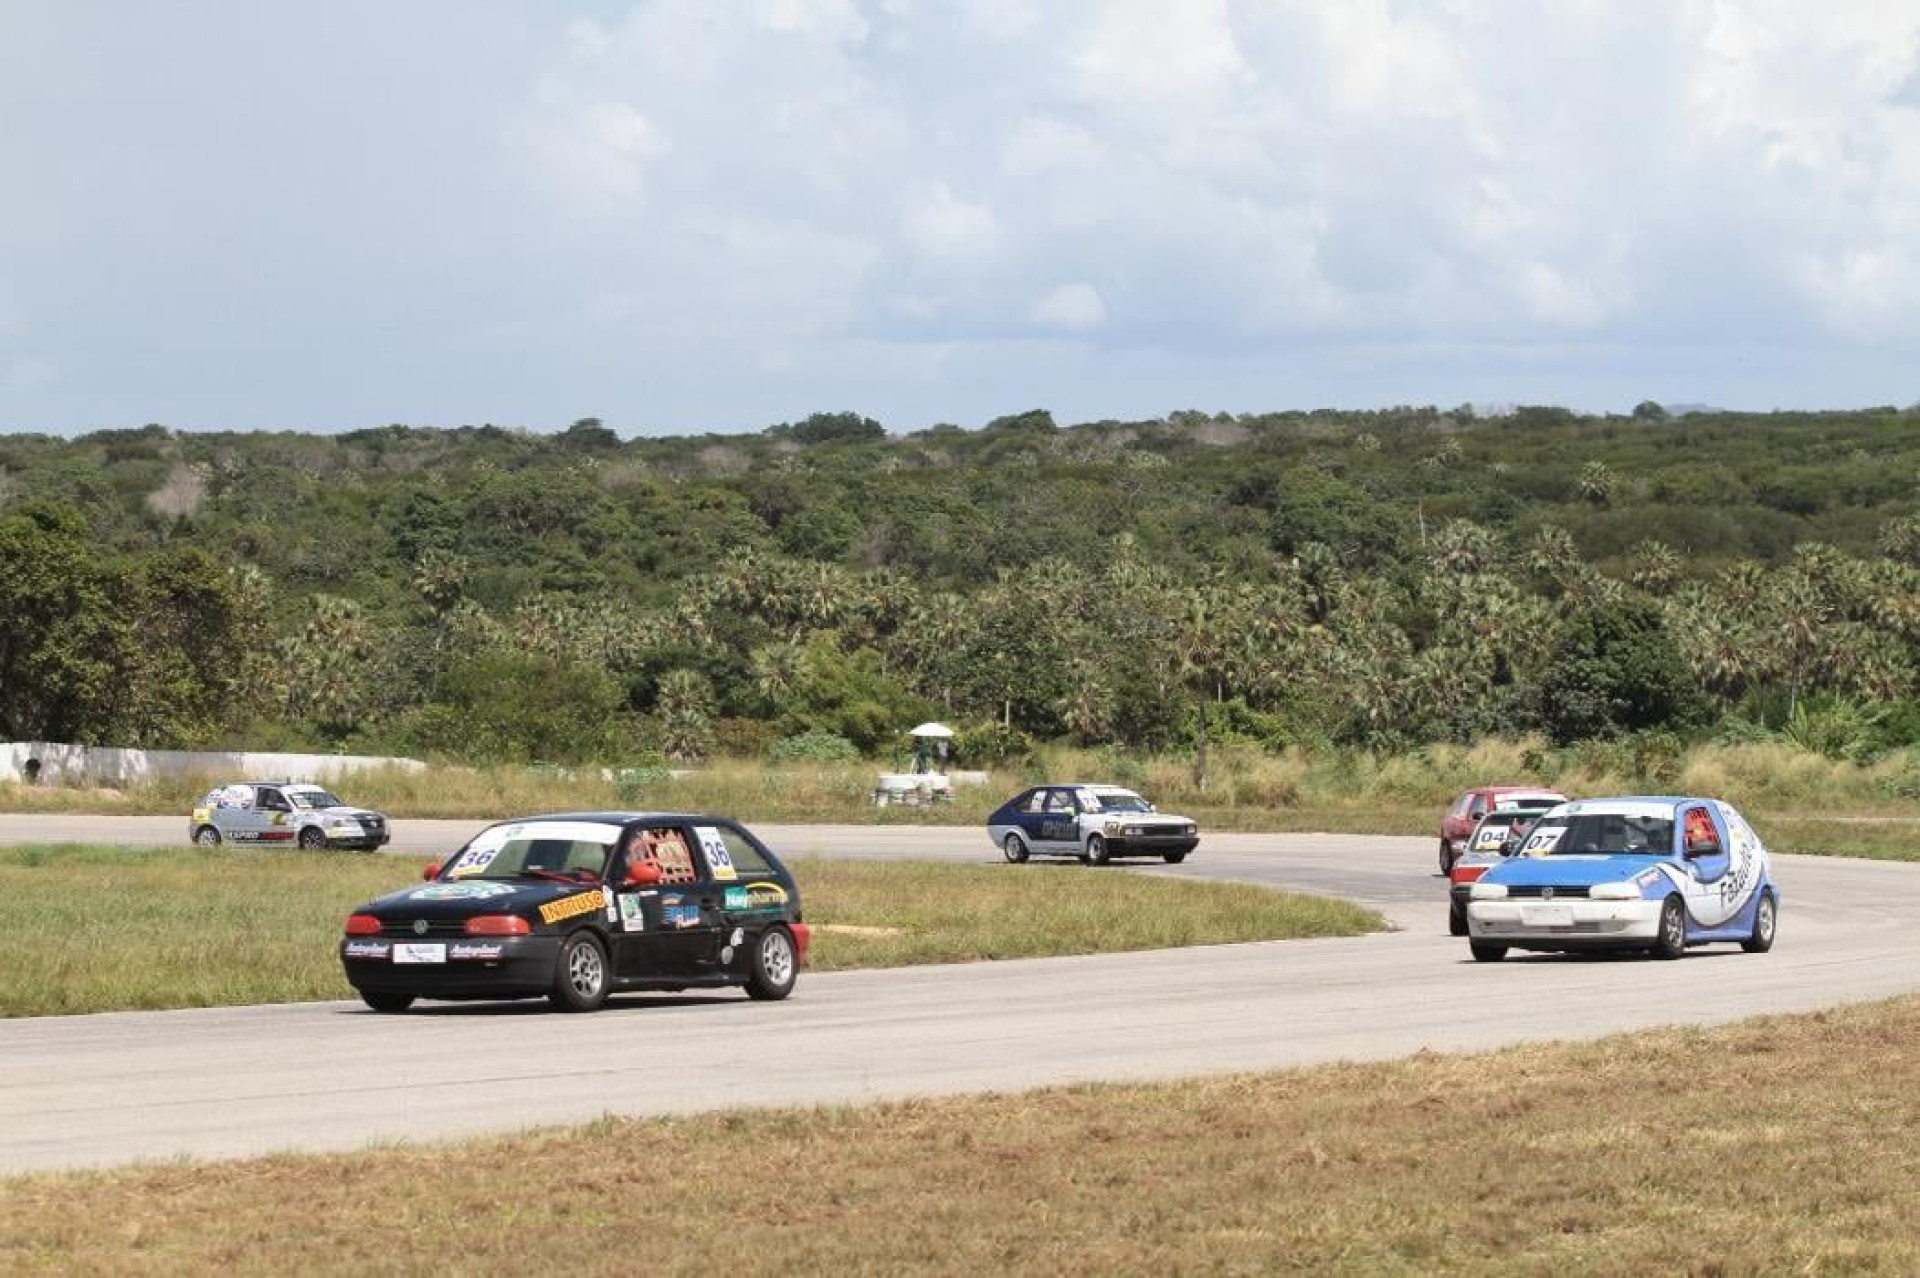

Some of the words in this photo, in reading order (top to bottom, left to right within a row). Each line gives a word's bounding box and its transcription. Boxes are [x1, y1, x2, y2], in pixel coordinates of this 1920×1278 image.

[1481, 831, 1505, 843] 04
[1526, 834, 1558, 850] 07
[458, 850, 496, 868] 36
[704, 841, 730, 867] 36
